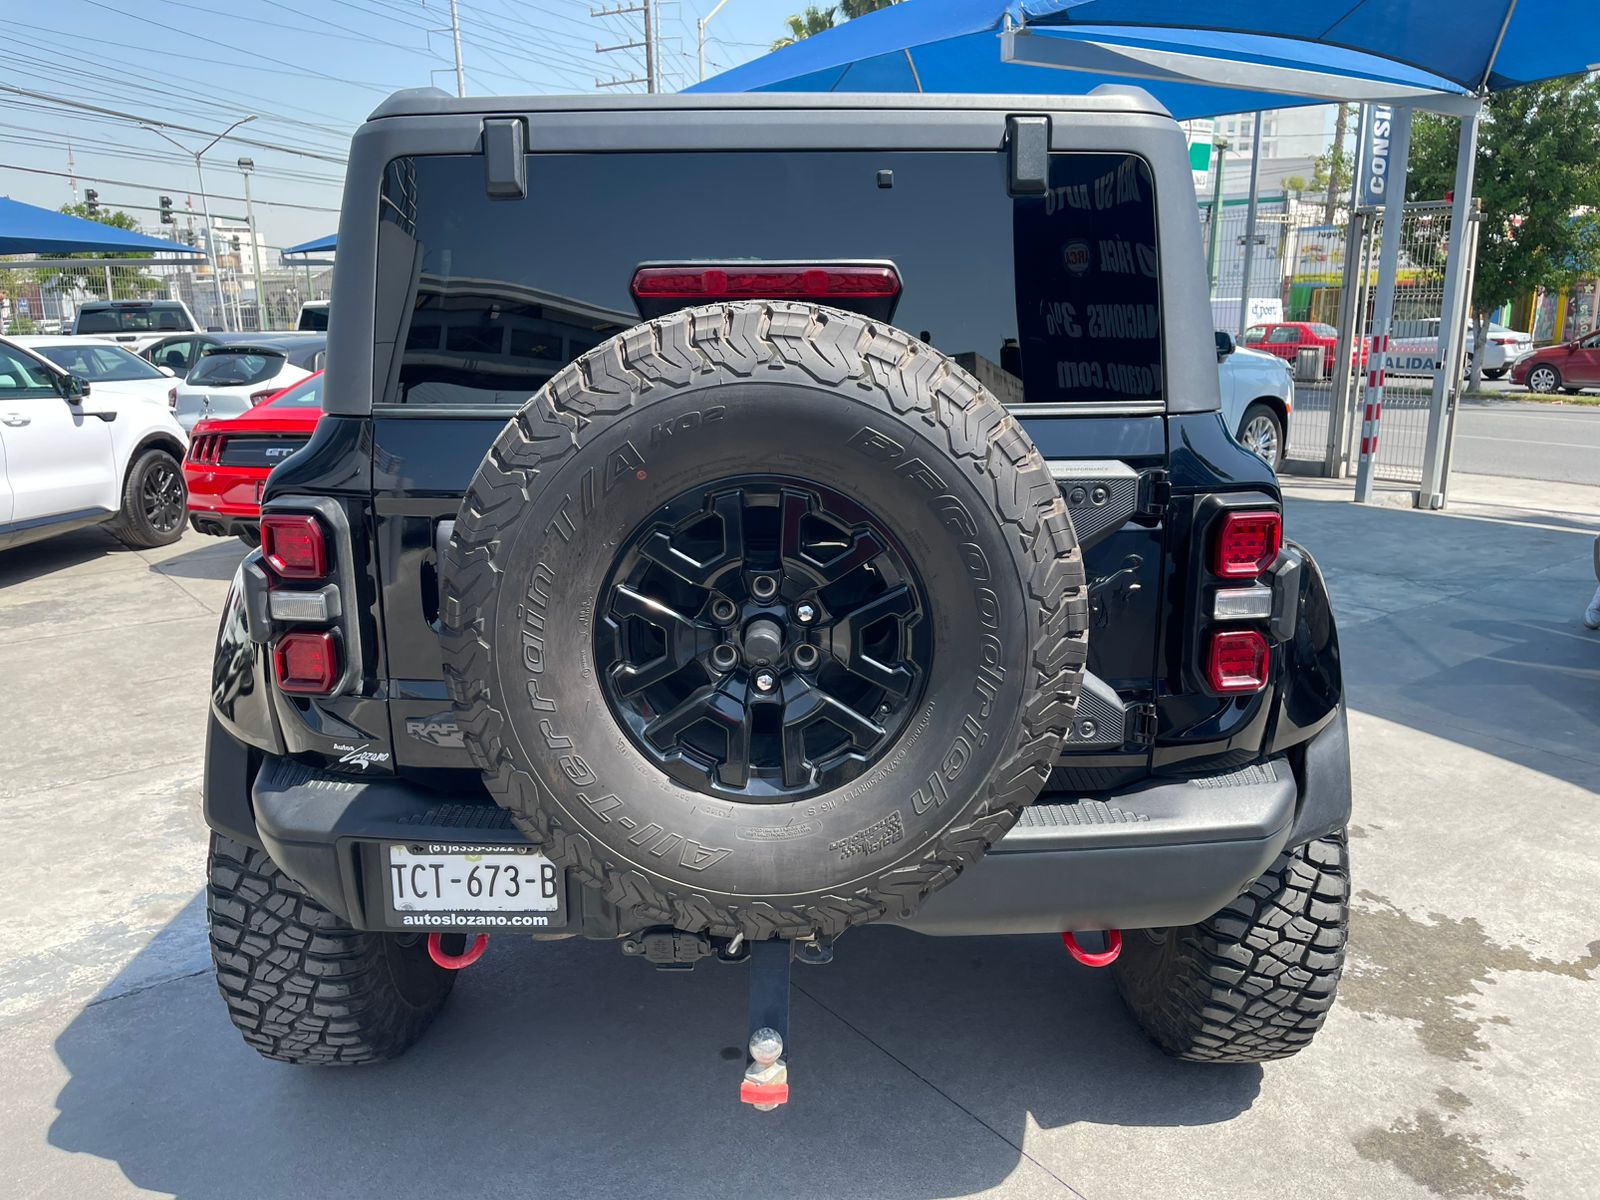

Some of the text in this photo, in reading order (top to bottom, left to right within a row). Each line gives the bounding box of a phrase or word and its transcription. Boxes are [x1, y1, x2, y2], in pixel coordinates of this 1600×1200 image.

[1386, 357, 1435, 370] ALIDA
[265, 447, 294, 457] GT
[847, 425, 1007, 815] BFGoodrich
[518, 562, 734, 871] All-Terrain
[407, 722, 459, 736] RAP
[333, 743, 355, 751] Autos
[390, 863, 557, 899] TCT-673-B
[403, 913, 549, 926] autoslozano.com
